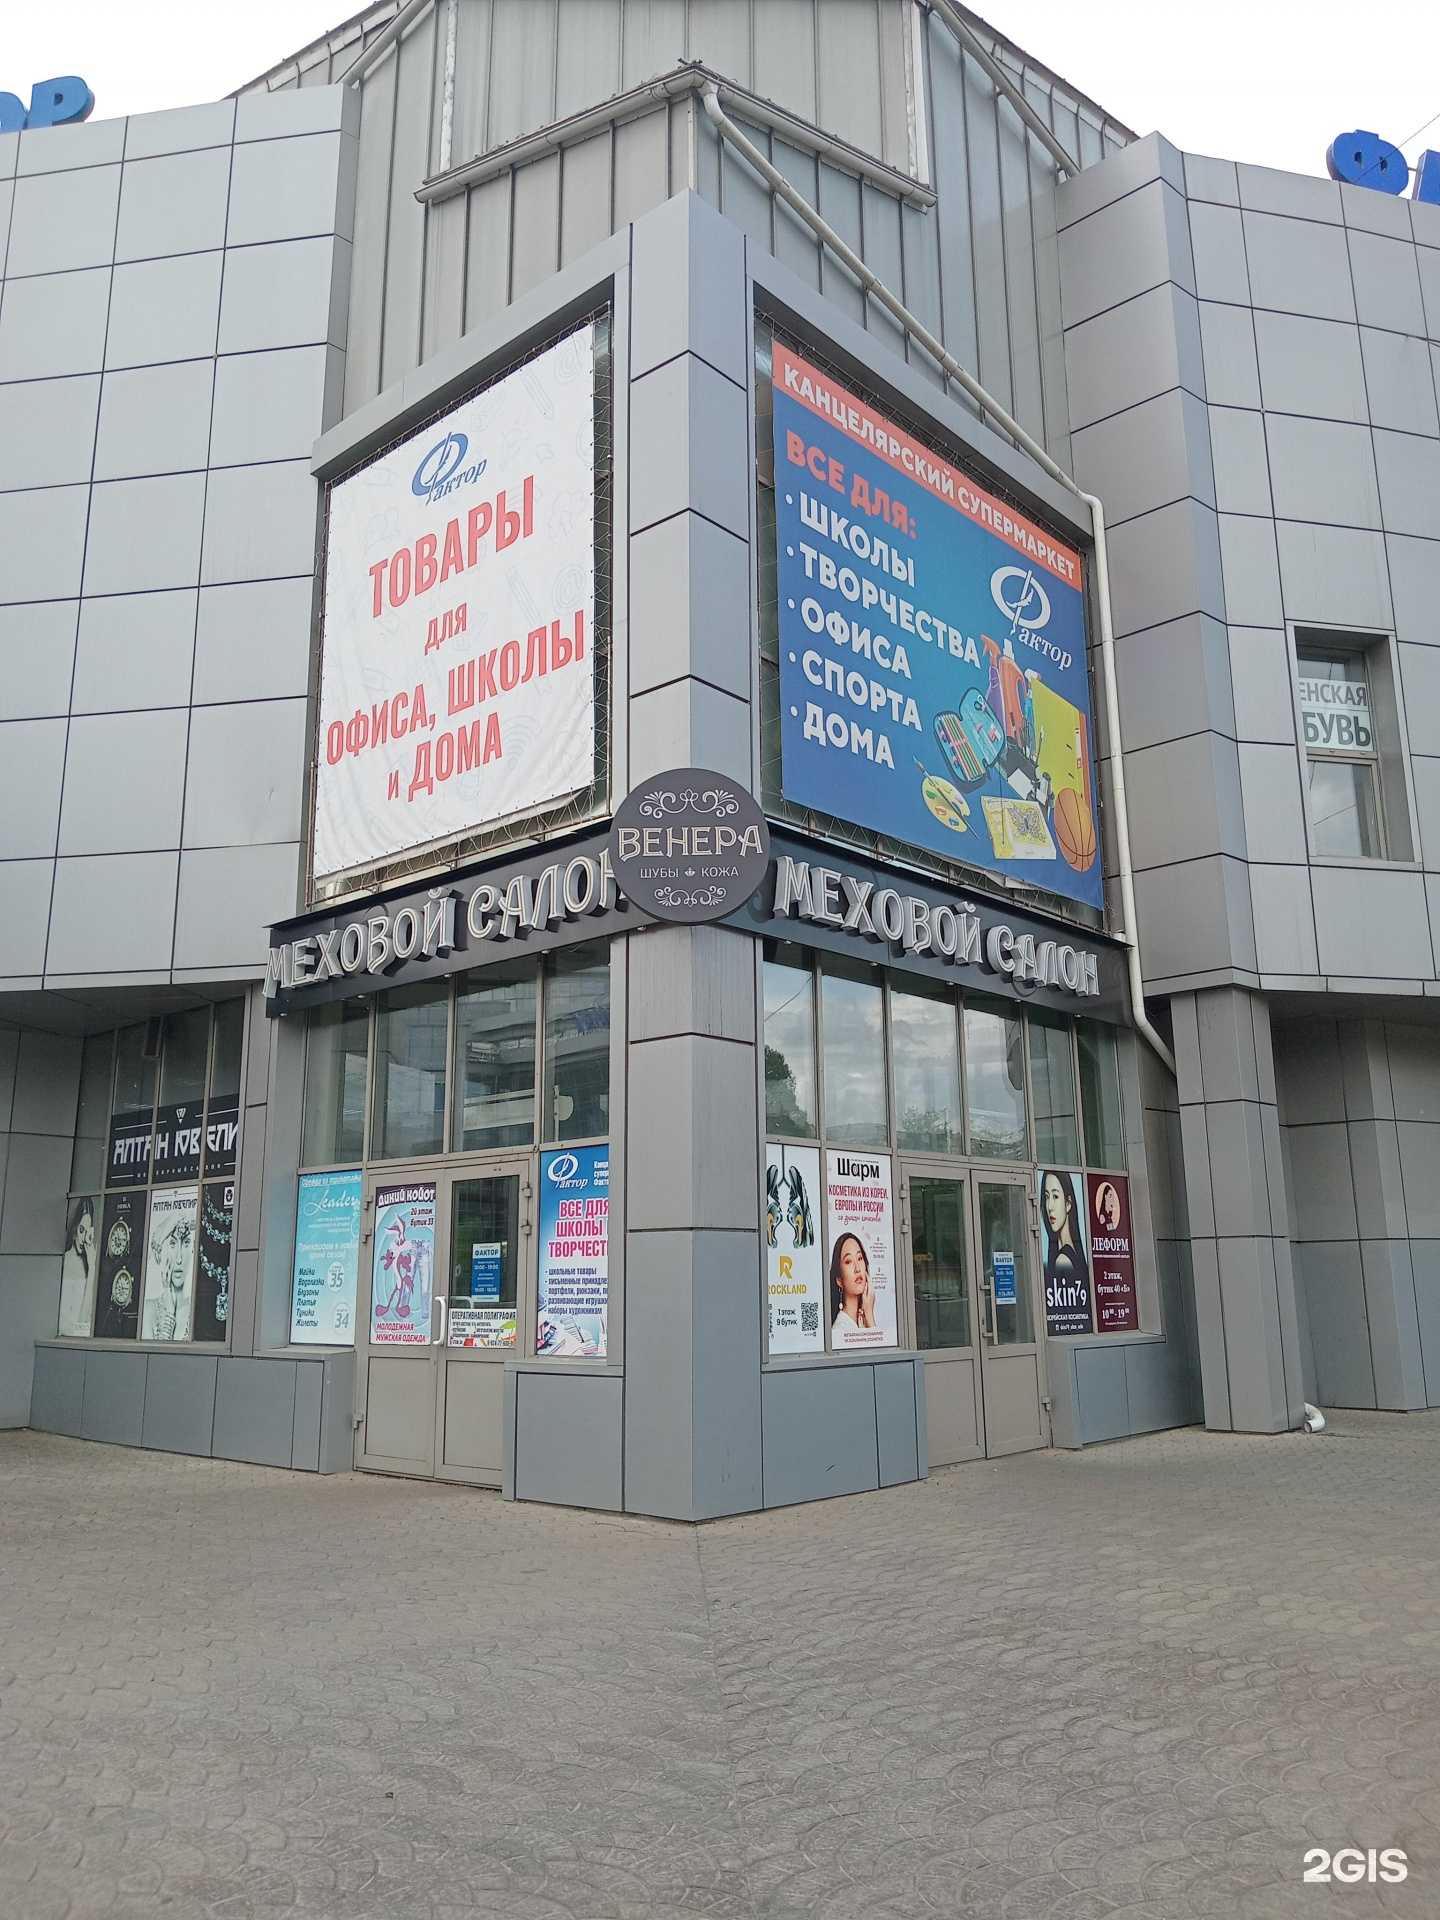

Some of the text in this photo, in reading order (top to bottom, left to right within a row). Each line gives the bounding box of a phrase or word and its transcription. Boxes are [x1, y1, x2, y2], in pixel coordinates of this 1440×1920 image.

[784, 362, 1075, 580] КАНЦЕЛЯРСКИЙ СУПЕРМАРКЕТ
[786, 429, 919, 540] ВСЕ ДЛЯ:
[369, 474, 534, 618] ТОВАРЫ
[800, 491, 915, 588] ШКОЛЫ
[800, 542, 981, 669] ТВОРЧЕСТВА
[801, 597, 912, 680] ОФИСА
[327, 609, 584, 766] ОФИСА, ШКОЛЫ
[802, 649, 922, 732] СПОРТА
[803, 700, 895, 770] ДОМА
[1302, 711, 1371, 746] БУВЬ
[408, 712, 503, 802] ДОМА
[618, 825, 763, 862] ВЕНЕРА
[640, 866, 739, 879] ШУБЫ КОЖА
[262, 887, 456, 999] МЕХОВОЙ
[773, 855, 1101, 997] МЕХОВОЙ САЛОН
[828, 1184, 861, 1197] КОСМЕТИКА
[862, 1186, 870, 1197] ИЗ
[837, 1158, 880, 1181] Шарм
[556, 1220, 603, 1238] ШКОЛЫ
[560, 1200, 582, 1217] ВСЕ
[835, 1199, 858, 1211] ЕВРОПЫ
[330, 1272, 344, 1288] 35
[577, 1268, 597, 1276] товары
[335, 1313, 350, 1329] 34
[451, 1311, 516, 1320] ОПЕРАТИВНАЯ ПОЛИГРАФИЯ
